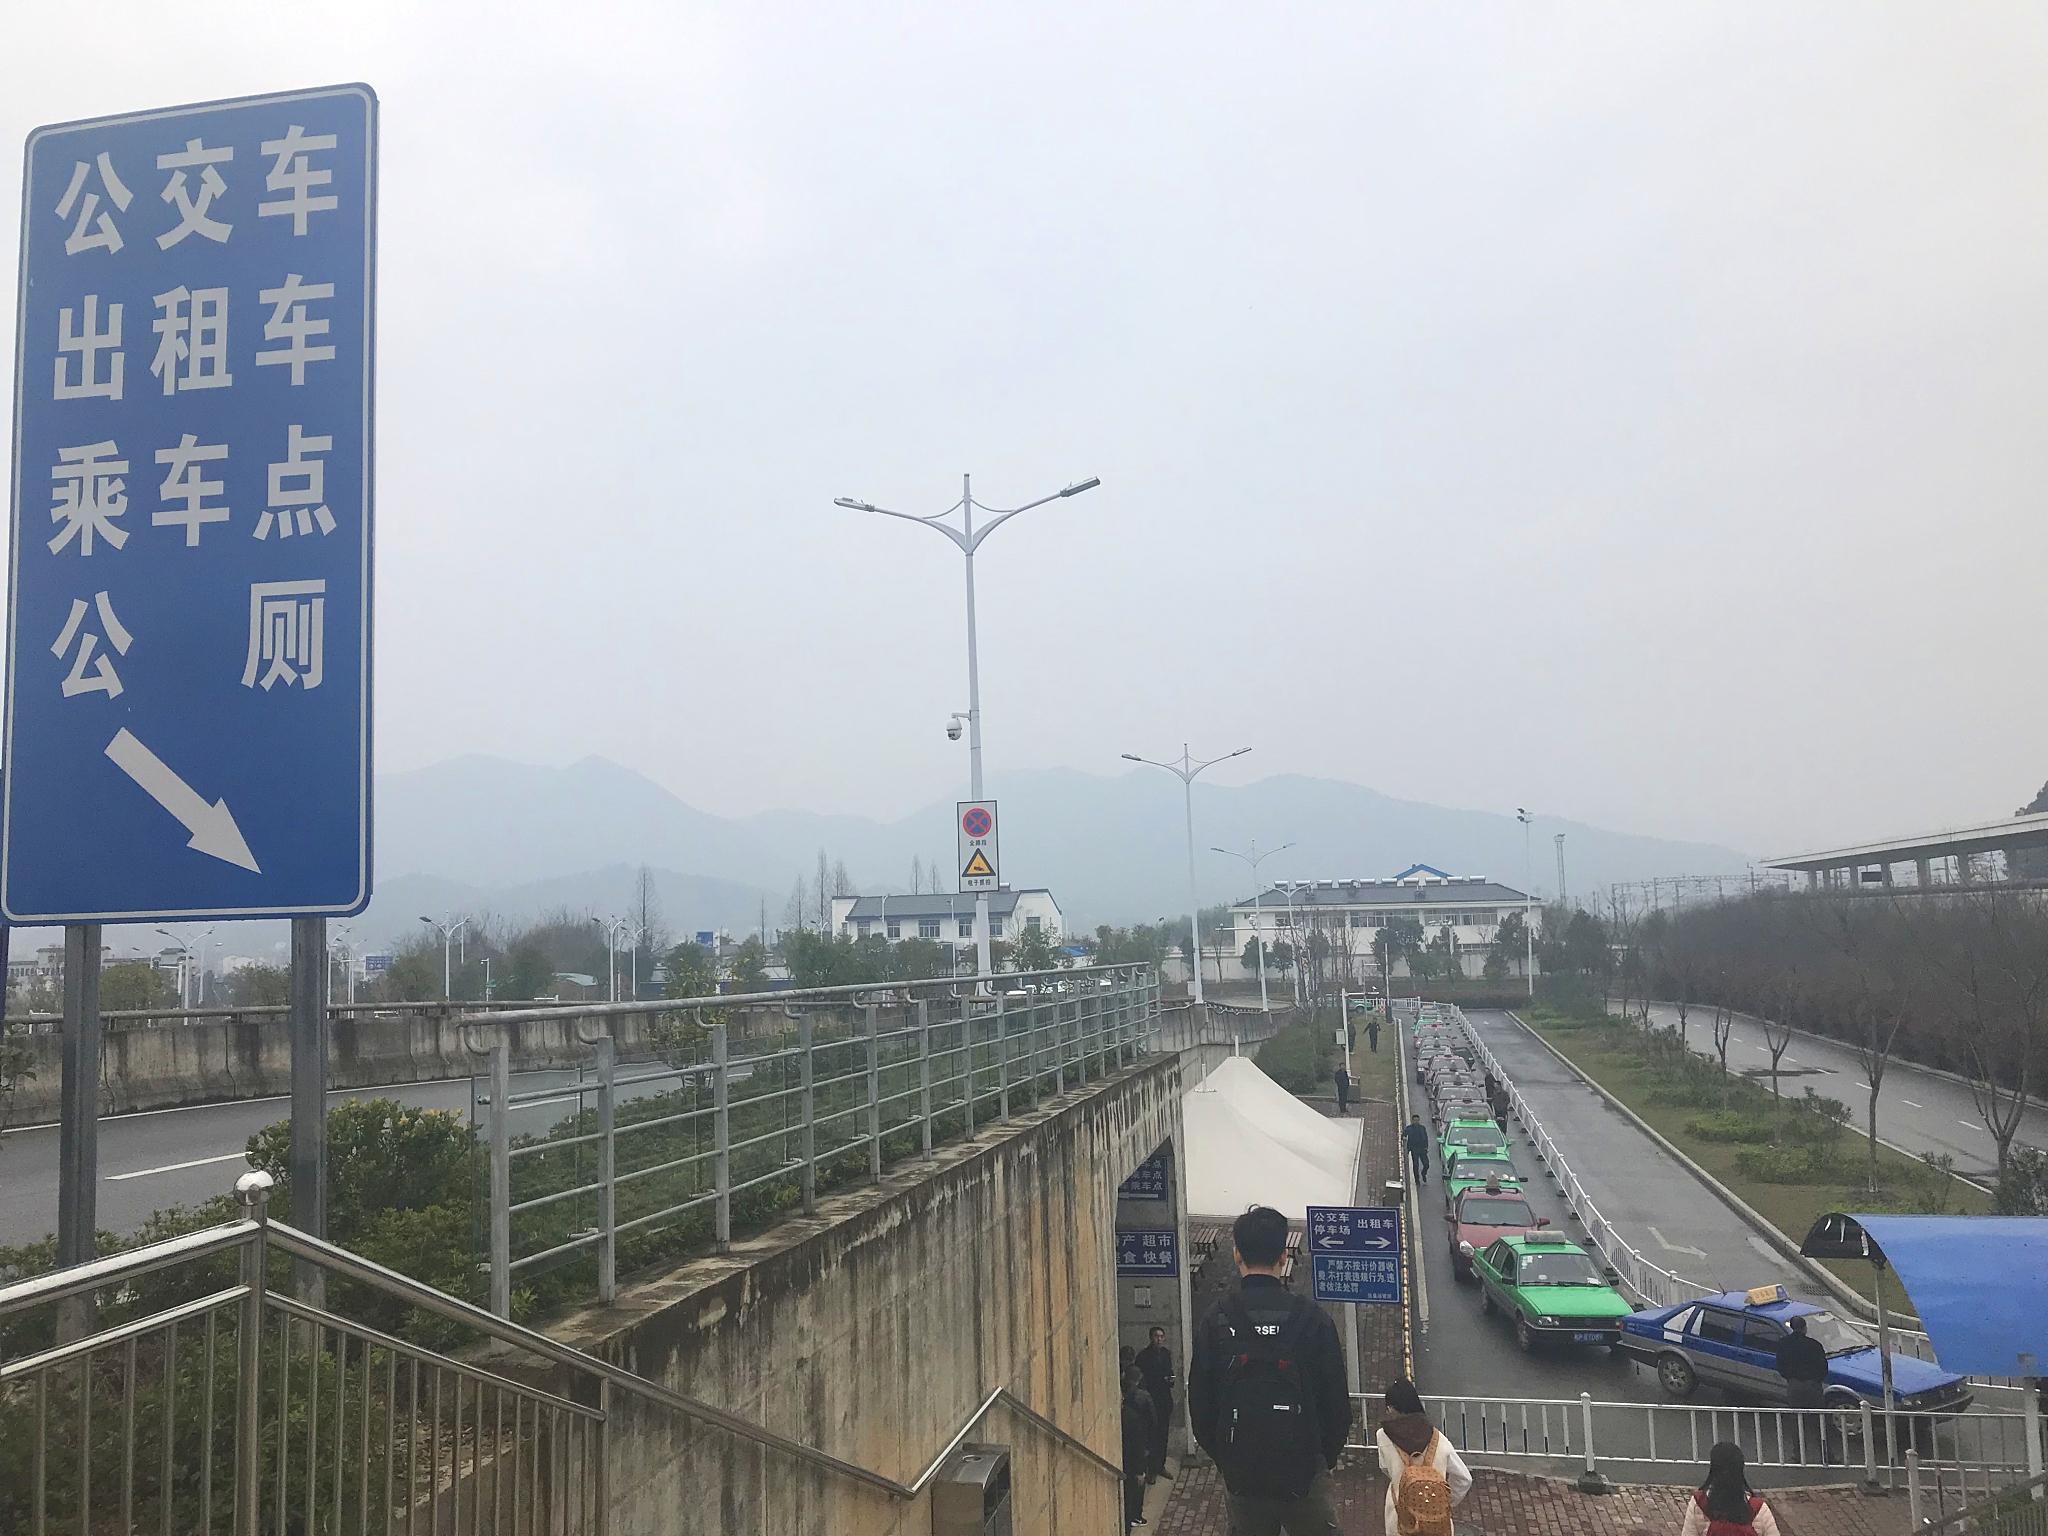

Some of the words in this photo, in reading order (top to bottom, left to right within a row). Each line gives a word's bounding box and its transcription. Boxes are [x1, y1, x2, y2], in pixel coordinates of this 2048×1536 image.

[54, 125, 338, 256] 公交车
[53, 273, 336, 401] 出租车
[46, 425, 337, 556] 乘车点
[50, 579, 326, 699] 公厕
[1314, 1212, 1350, 1223] 公交车
[1357, 1218, 1394, 1229] 出租车
[1314, 1224, 1351, 1235] 停车场
[1142, 1234, 1172, 1247] 超市
[1143, 1250, 1173, 1264] 快餐
